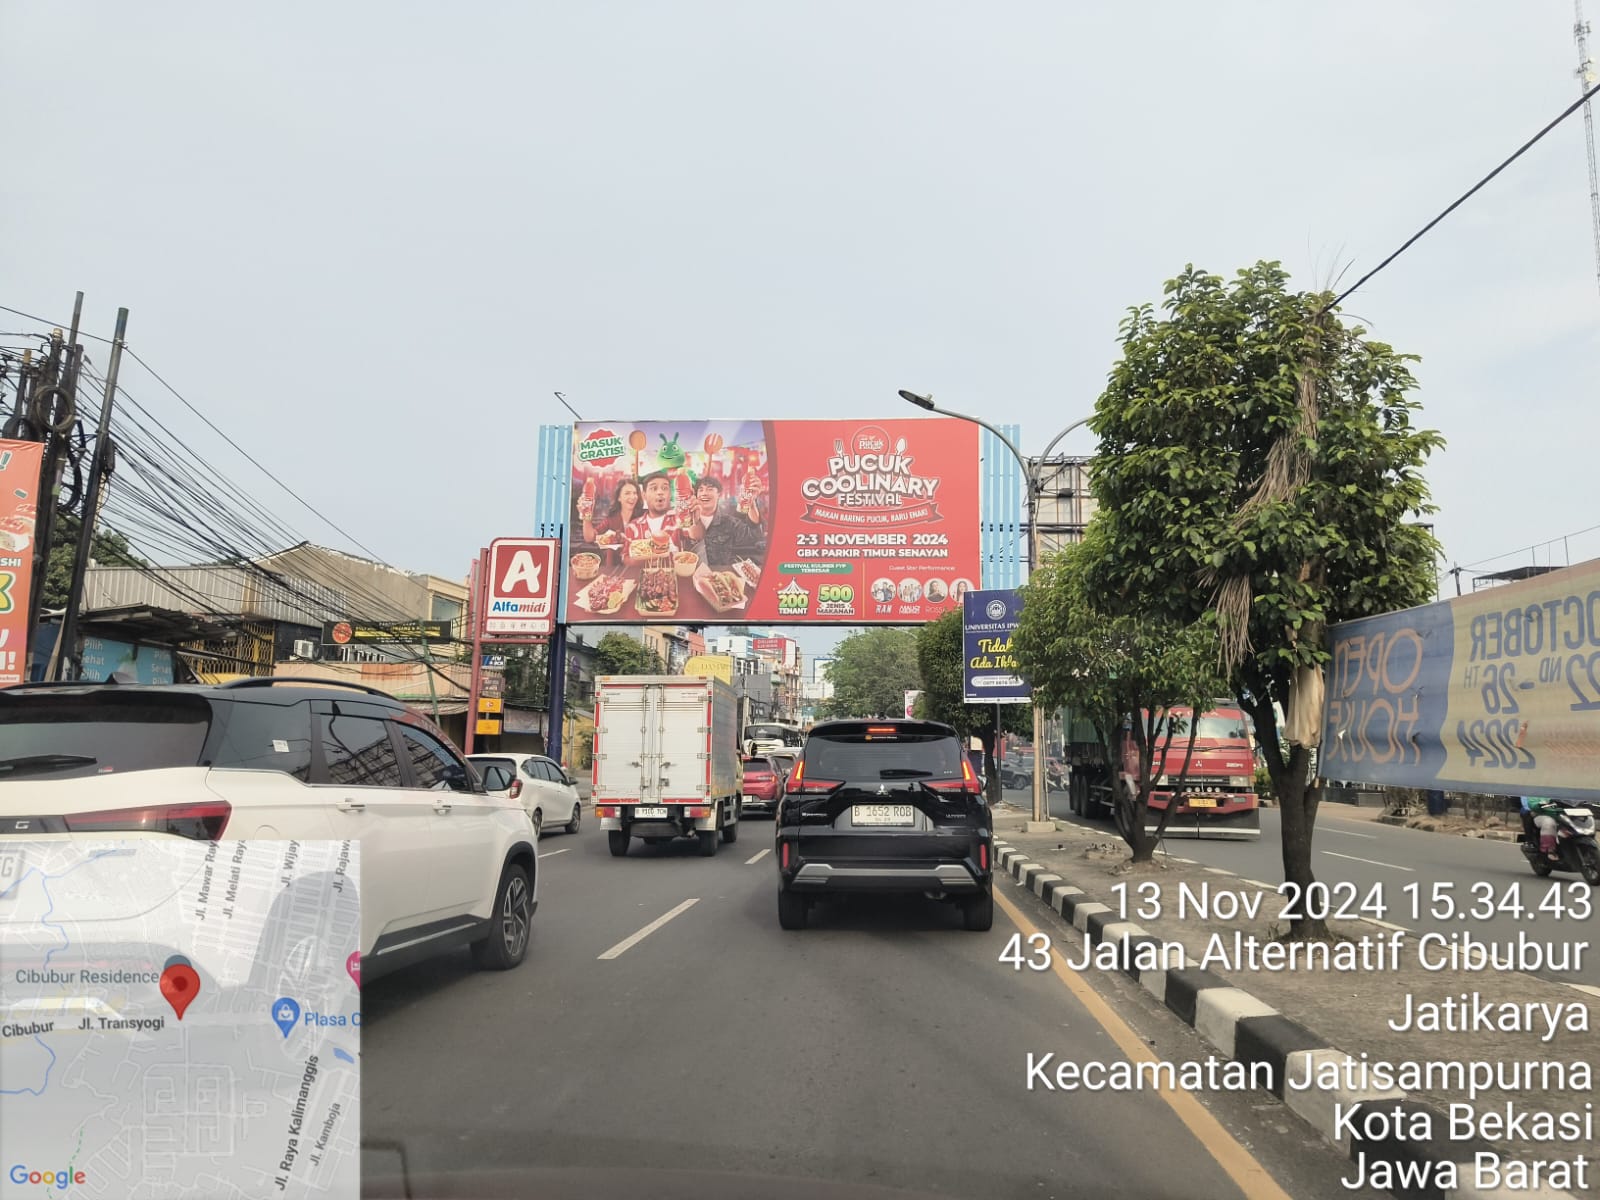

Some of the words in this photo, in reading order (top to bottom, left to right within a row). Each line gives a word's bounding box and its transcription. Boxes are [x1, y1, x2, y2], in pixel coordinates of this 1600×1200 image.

[580, 437, 622, 450] MASUK
[580, 446, 624, 460] GRATIS!
[829, 453, 913, 476] PUCUK
[802, 473, 939, 498] COOLINARY
[838, 493, 902, 506] FESTIVAL
[815, 508, 839, 521] MAKAN
[839, 513, 865, 523] BARENG
[891, 512, 908, 522] BARU
[796, 534, 818, 545] 2-3
[824, 534, 907, 545] NOVEMBER
[912, 534, 949, 545] 2024
[797, 549, 820, 558] GBK
[821, 549, 860, 558] PARKIR
[862, 549, 896, 558] TIMUR
[898, 549, 948, 558] SENAYAN
[819, 586, 852, 602] 500
[492, 600, 547, 613] Alfamidi
[778, 594, 809, 608] 200
[965, 622, 1006, 631] UNIVERSITAS
[970, 655, 993, 669] Ada
[854, 806, 861, 817] B
[866, 806, 890, 817] 1652
